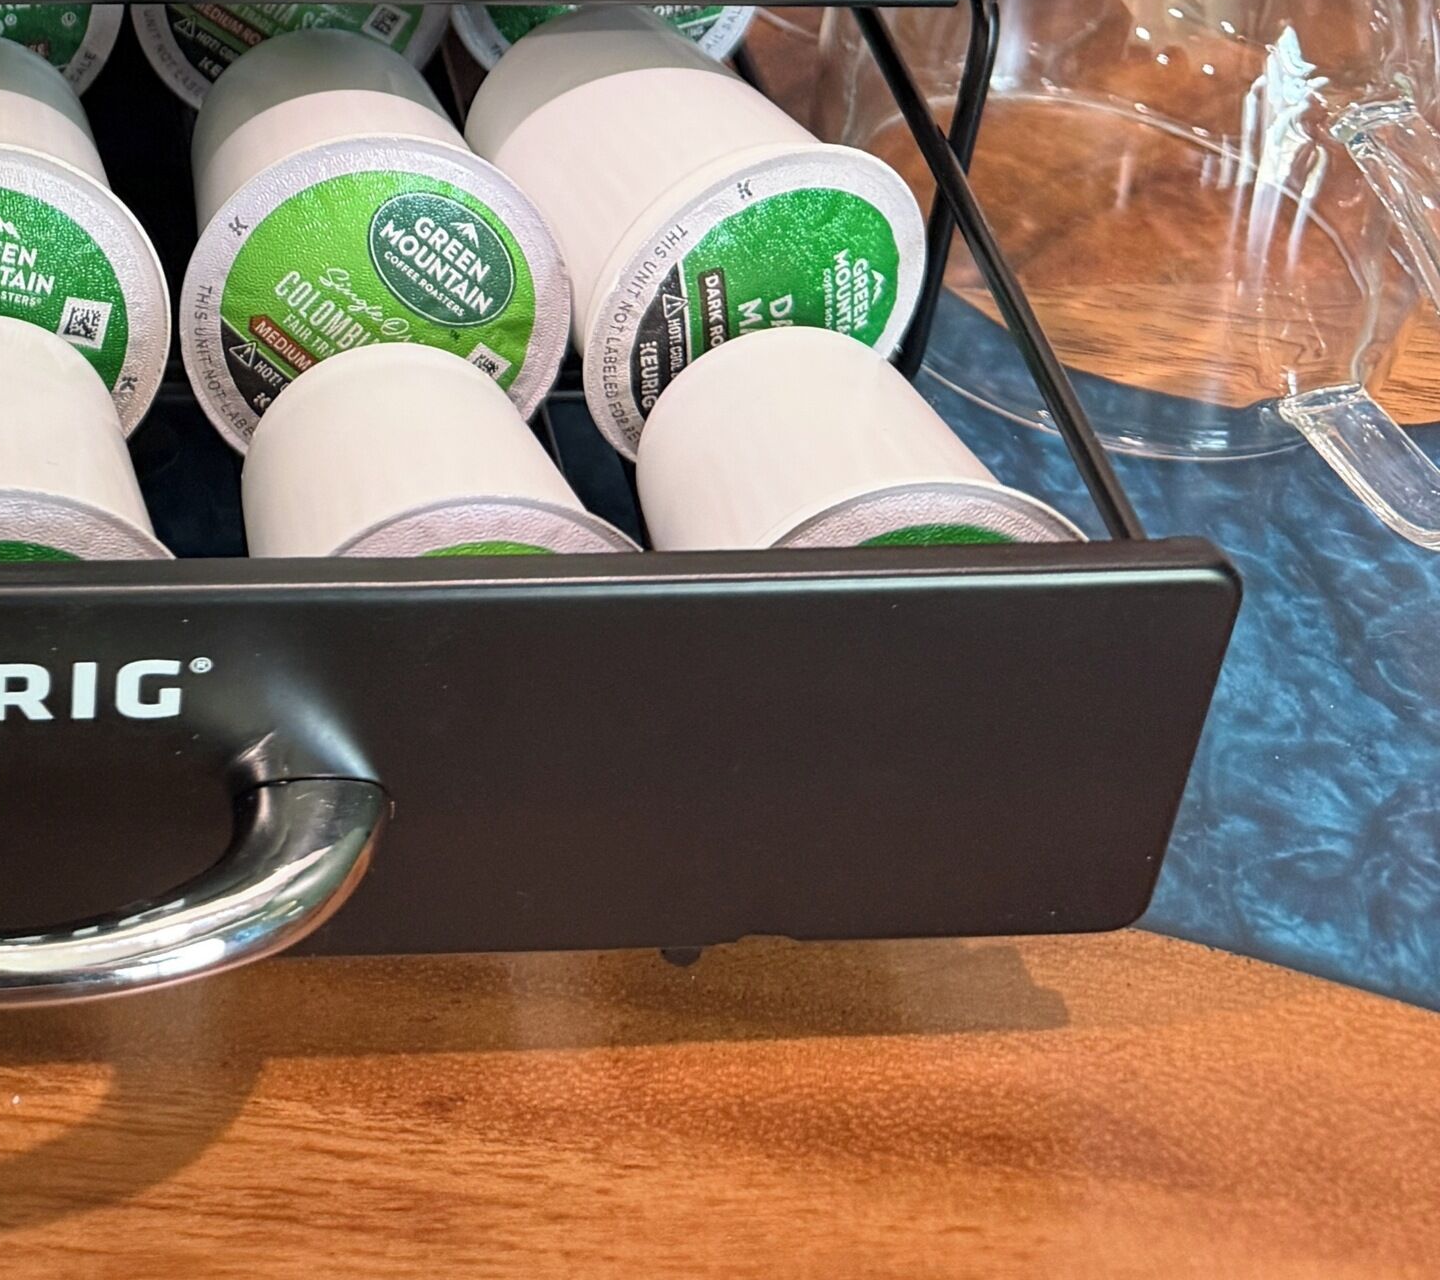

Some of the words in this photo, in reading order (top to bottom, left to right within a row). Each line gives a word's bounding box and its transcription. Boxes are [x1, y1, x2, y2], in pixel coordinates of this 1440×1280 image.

[414, 216, 491, 283] GREEN
[654, 224, 689, 259] THIS
[379, 219, 494, 316] MOUNTAIN
[384, 251, 421, 281] COFFEE
[418, 278, 465, 317] ROASTERS
[626, 260, 658, 299] UNIT
[194, 285, 213, 322] THIS
[319, 267, 384, 321] Single
[610, 300, 633, 333] NOT
[704, 274, 724, 322] DARK
[853, 258, 869, 331] GREEN
[193, 327, 213, 364] UNIT
[254, 320, 312, 371] MEDIUM
[283, 313, 312, 341] FAIR
[311, 335, 337, 357] TRA
[667, 317, 683, 347] HOT!
[202, 370, 227, 397] NOT
[253, 360, 283, 387] HOT!
[602, 336, 621, 399] LABELED
[639, 341, 659, 409] KEURIG
